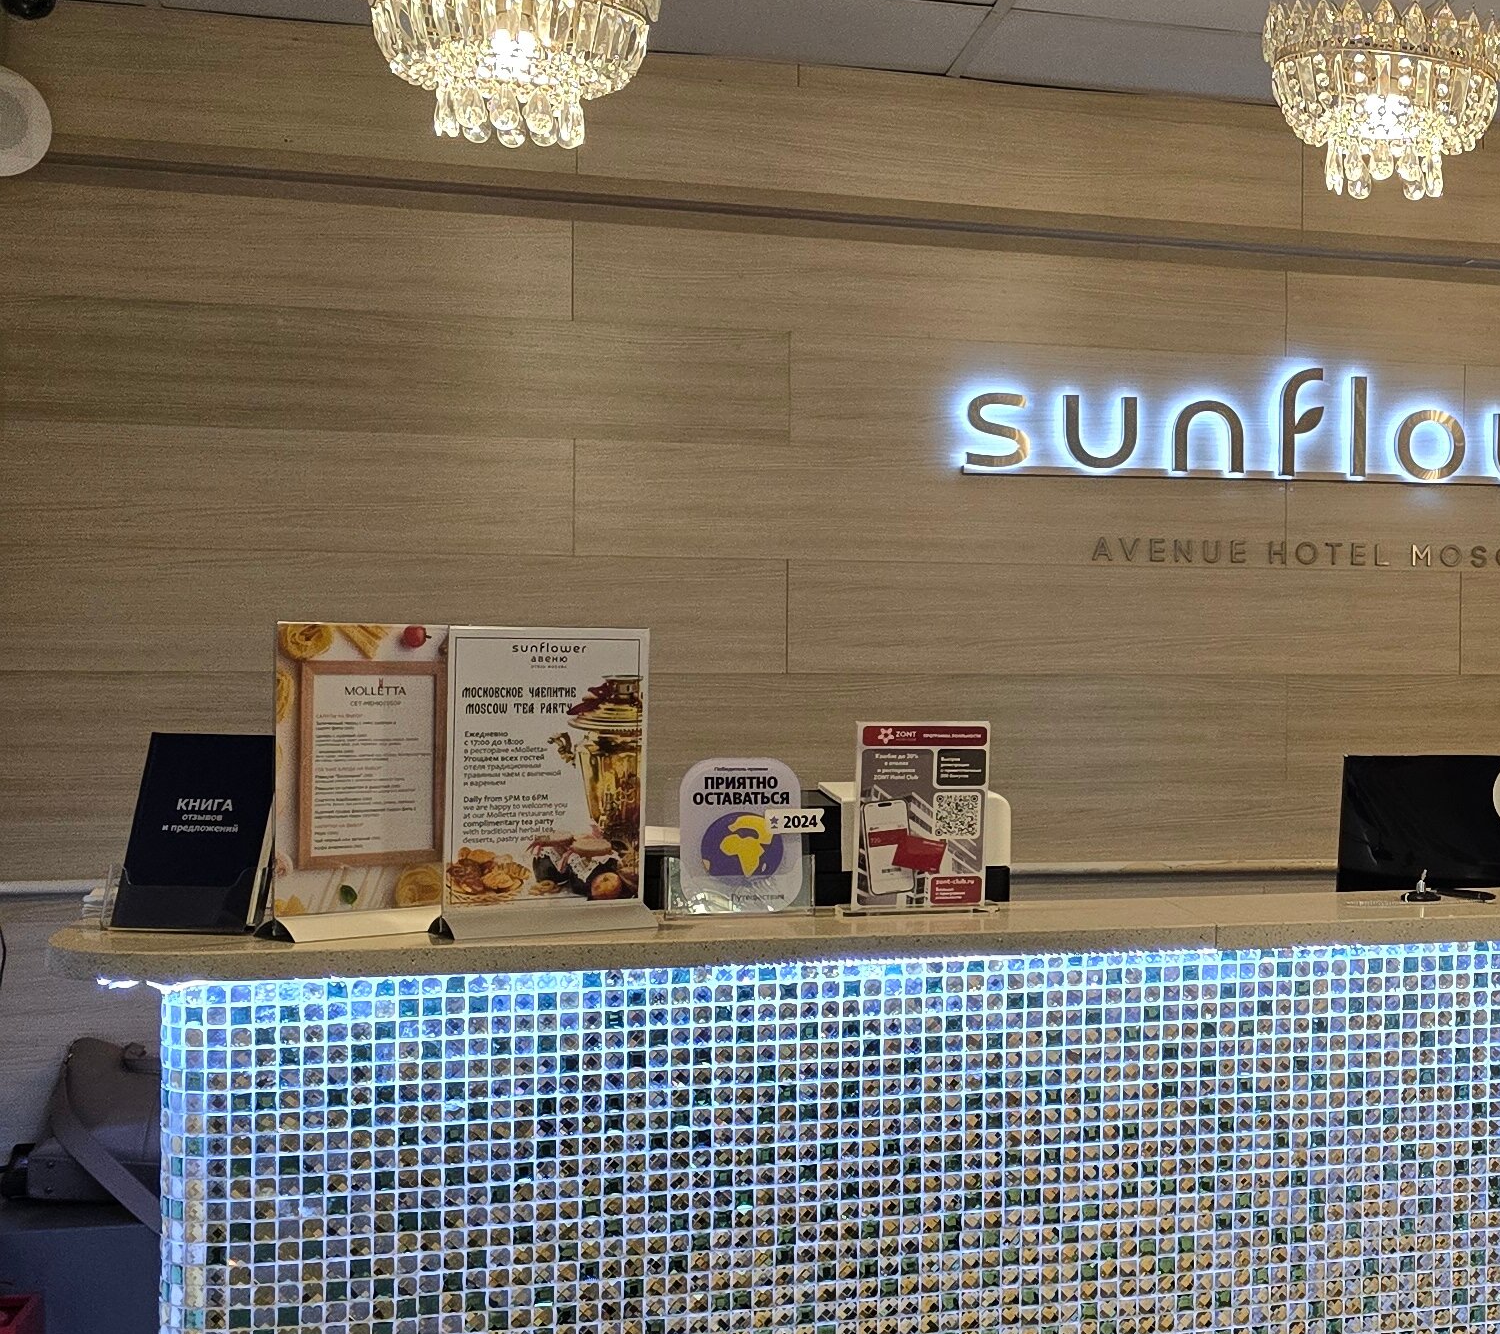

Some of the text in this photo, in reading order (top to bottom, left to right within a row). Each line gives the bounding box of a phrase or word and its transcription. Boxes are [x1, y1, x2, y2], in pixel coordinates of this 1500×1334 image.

[1091, 536, 1247, 564] AVENUE
[1268, 540, 1390, 567] HOTEL
[512, 642, 587, 653] sunflower
[344, 686, 407, 696] MOLLETTA
[462, 687, 577, 698] МОСКОВСКОЕ ЧАЕПИТИЕ
[465, 702, 573, 714] MOSCOW TEA PARTY
[464, 730, 509, 738] Ежедневно
[704, 776, 778, 790] ПРИЯТНО
[463, 796, 482, 804] Daily
[692, 791, 790, 806] ОСТАВАТЬСЯ
[176, 798, 233, 811] КНИГА
[181, 813, 223, 821] отзывов
[783, 815, 819, 830] 2024
[170, 824, 239, 833] предложений
[463, 819, 520, 828] complimentary
[534, 818, 554, 826] party
